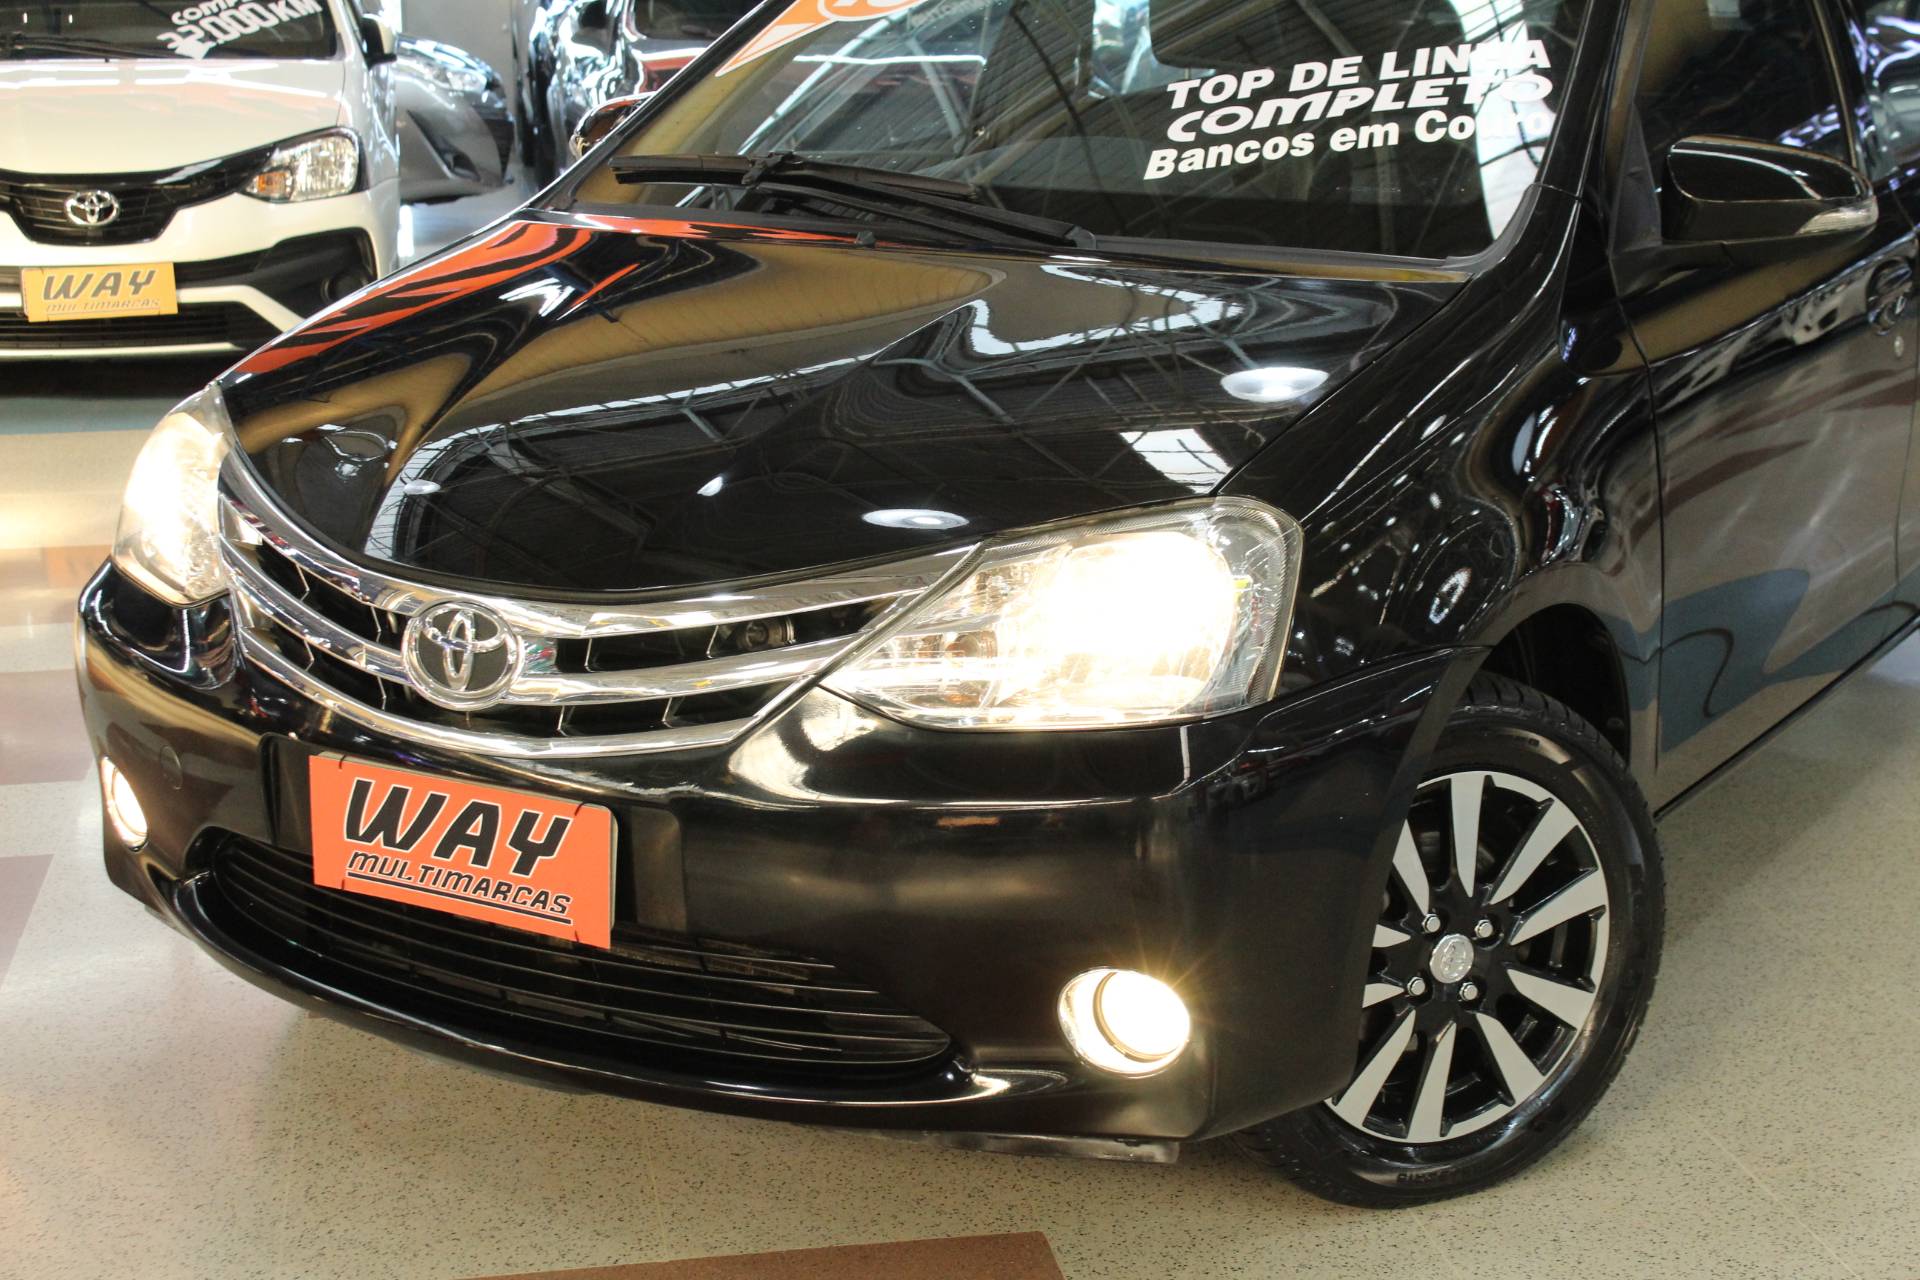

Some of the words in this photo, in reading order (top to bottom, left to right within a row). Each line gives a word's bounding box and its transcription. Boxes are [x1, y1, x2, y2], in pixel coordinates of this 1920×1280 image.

[1167, 69, 1275, 108] TOP
[1288, 56, 1363, 91] DE
[1167, 73, 1553, 142] COMPLETO
[1144, 130, 1315, 180] Bancos
[1330, 121, 1399, 152] em
[43, 269, 156, 301] WAY
[344, 777, 573, 876] WAY
[347, 851, 573, 916] MULTIMARCAS
